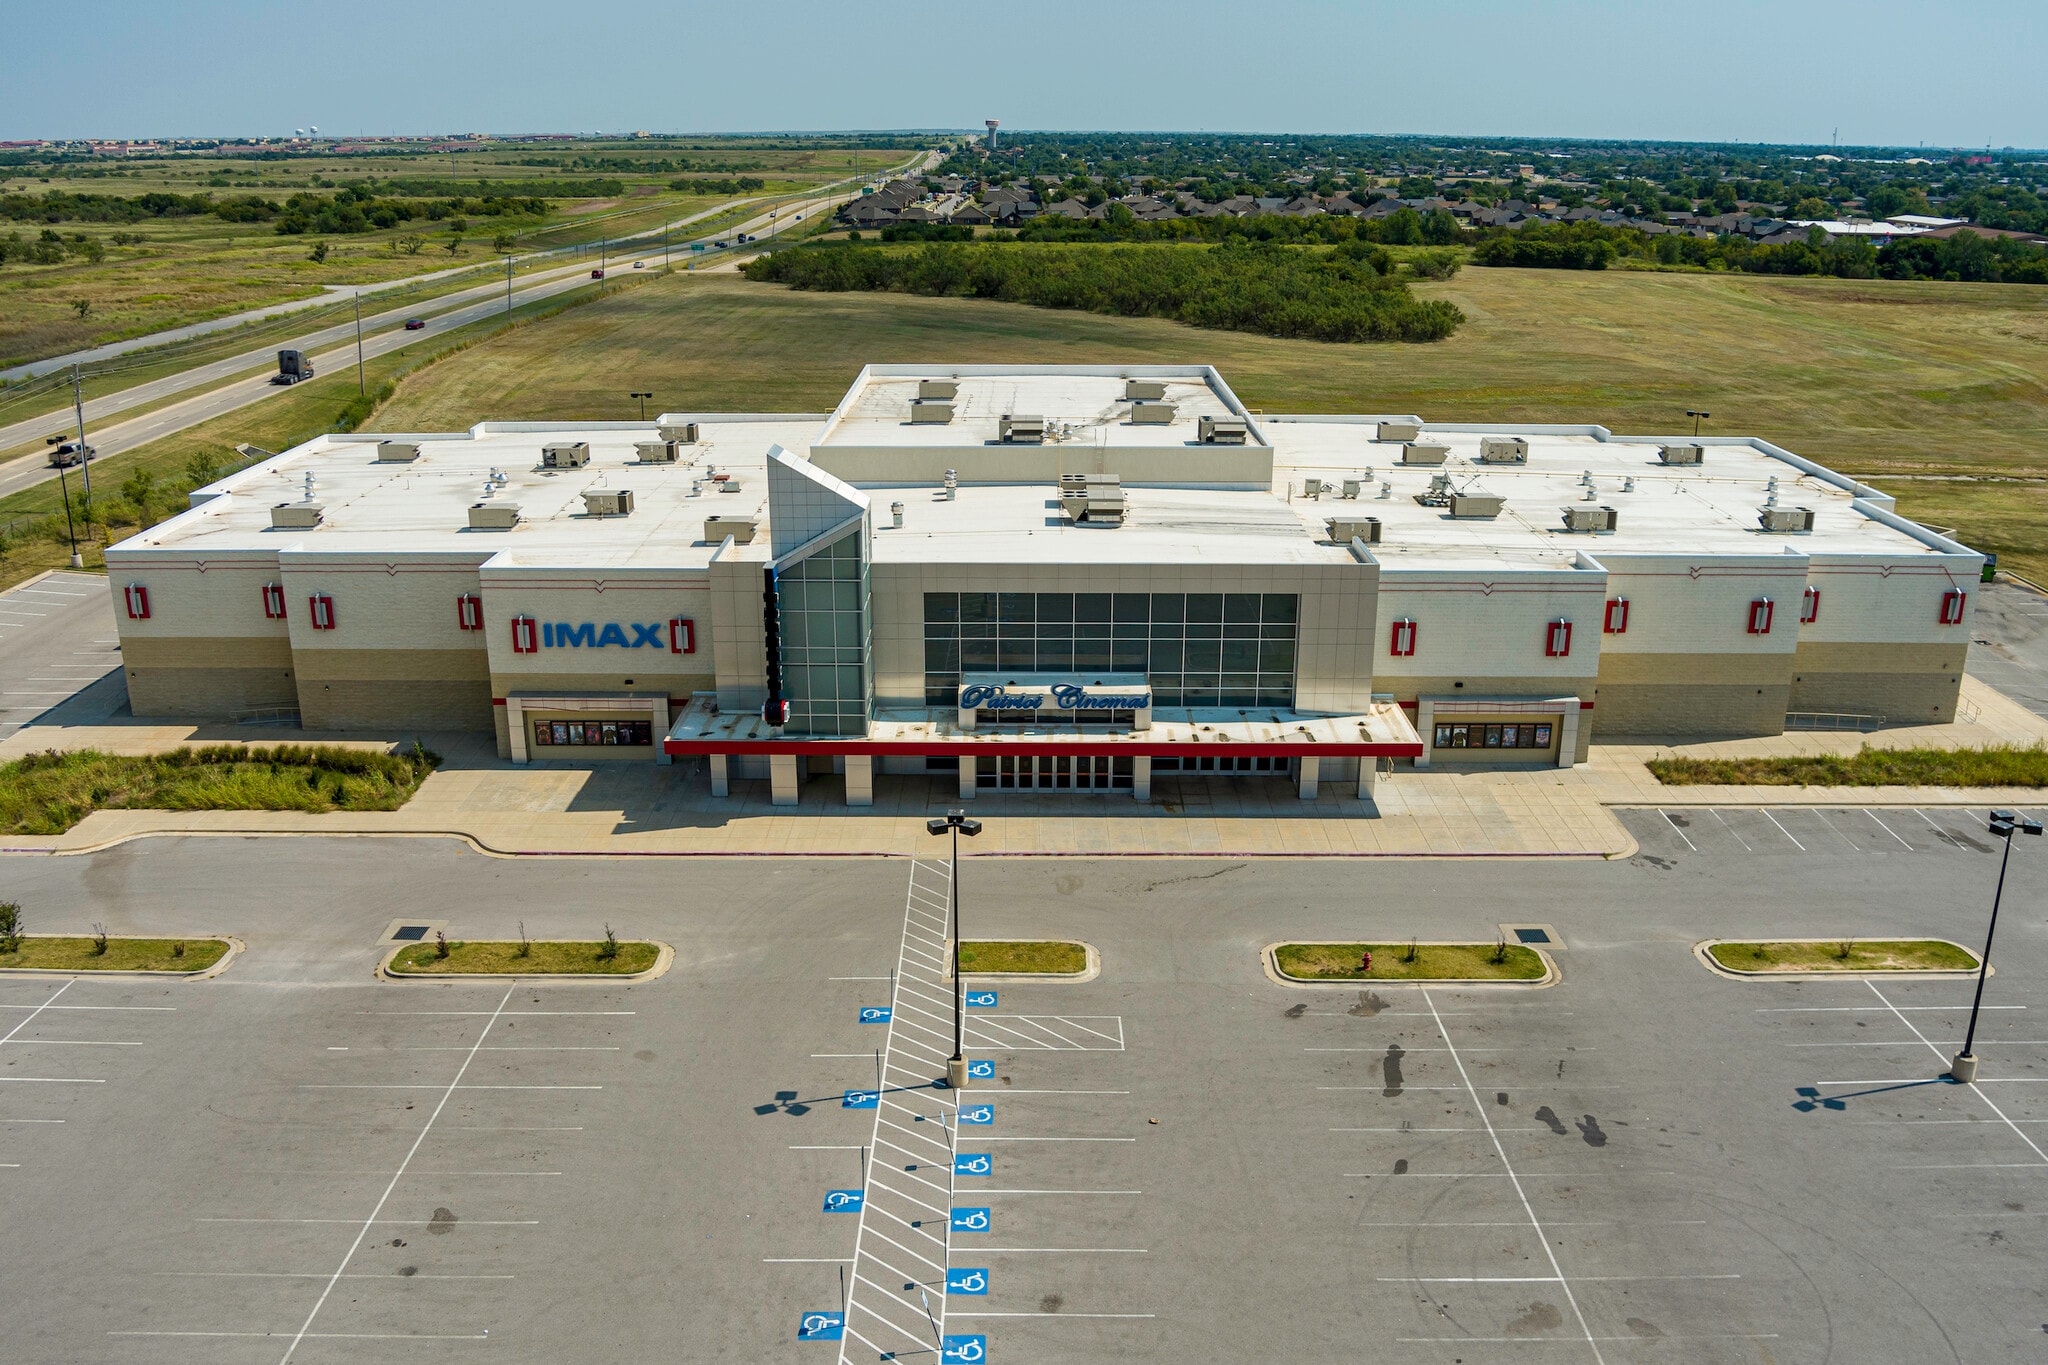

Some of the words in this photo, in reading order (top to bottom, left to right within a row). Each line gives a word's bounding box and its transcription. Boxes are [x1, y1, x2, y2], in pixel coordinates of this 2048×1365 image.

[543, 623, 664, 648] IMAX
[961, 683, 1043, 709] Patriot
[1051, 682, 1150, 709] Cinemas
